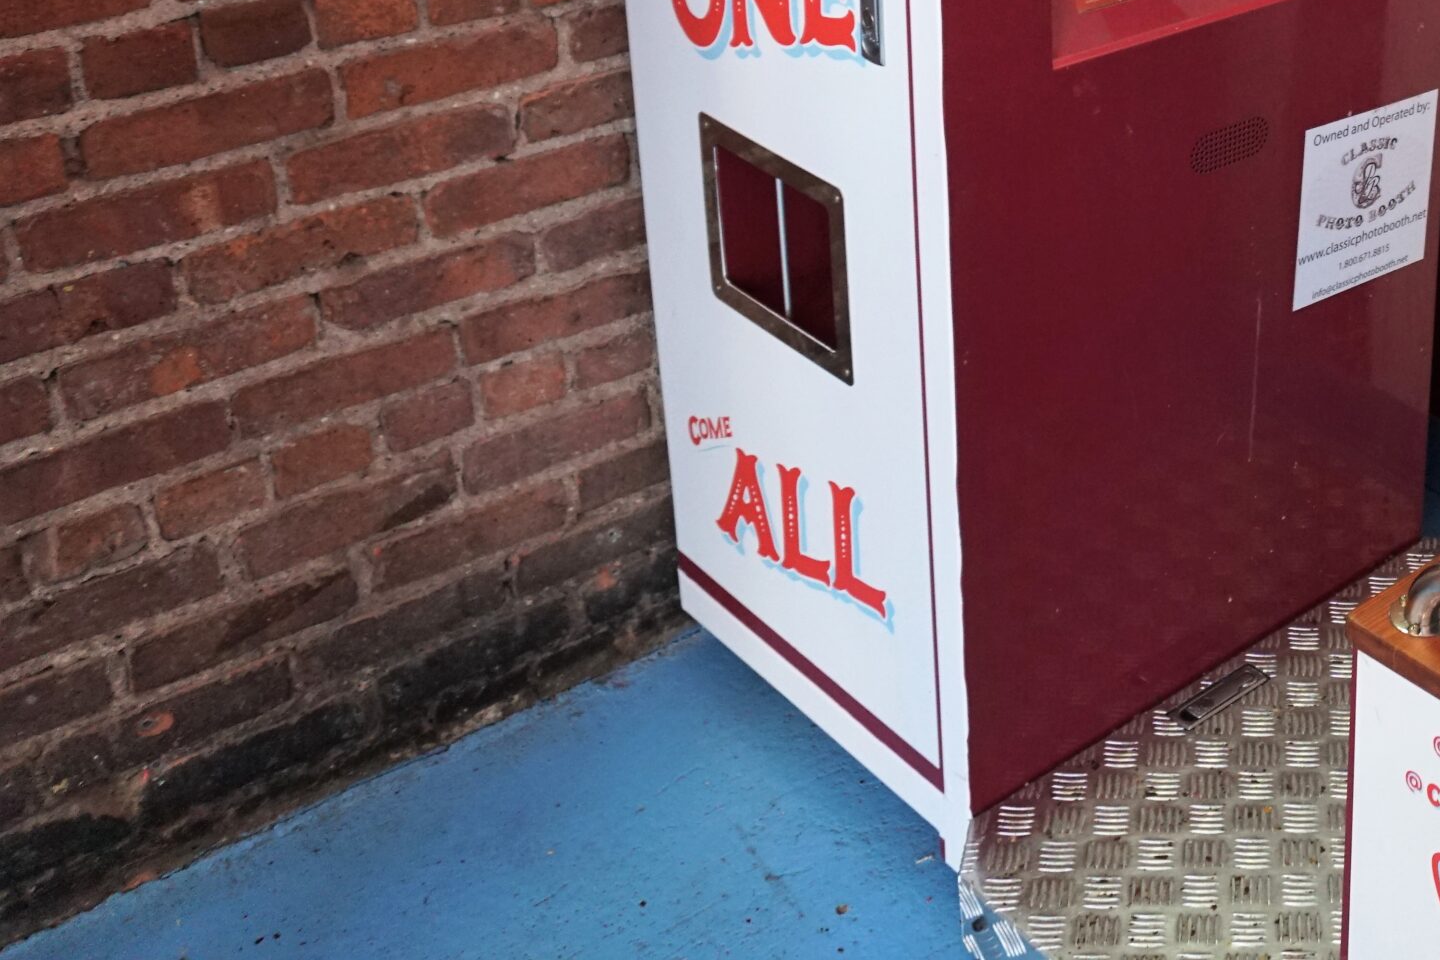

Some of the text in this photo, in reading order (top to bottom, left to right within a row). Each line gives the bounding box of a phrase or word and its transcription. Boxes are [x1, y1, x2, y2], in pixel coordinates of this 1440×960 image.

[1313, 101, 1431, 147] Owned and Operated by:
[1341, 136, 1398, 166] CLASSIC
[1316, 180, 1417, 230] PHOTO BOOTH
[1298, 209, 1427, 266] www.classicphotobooth.net
[1312, 254, 1409, 300] info@classicphotobooth.net
[688, 416, 732, 445] COME
[716, 447, 886, 619] ALL
